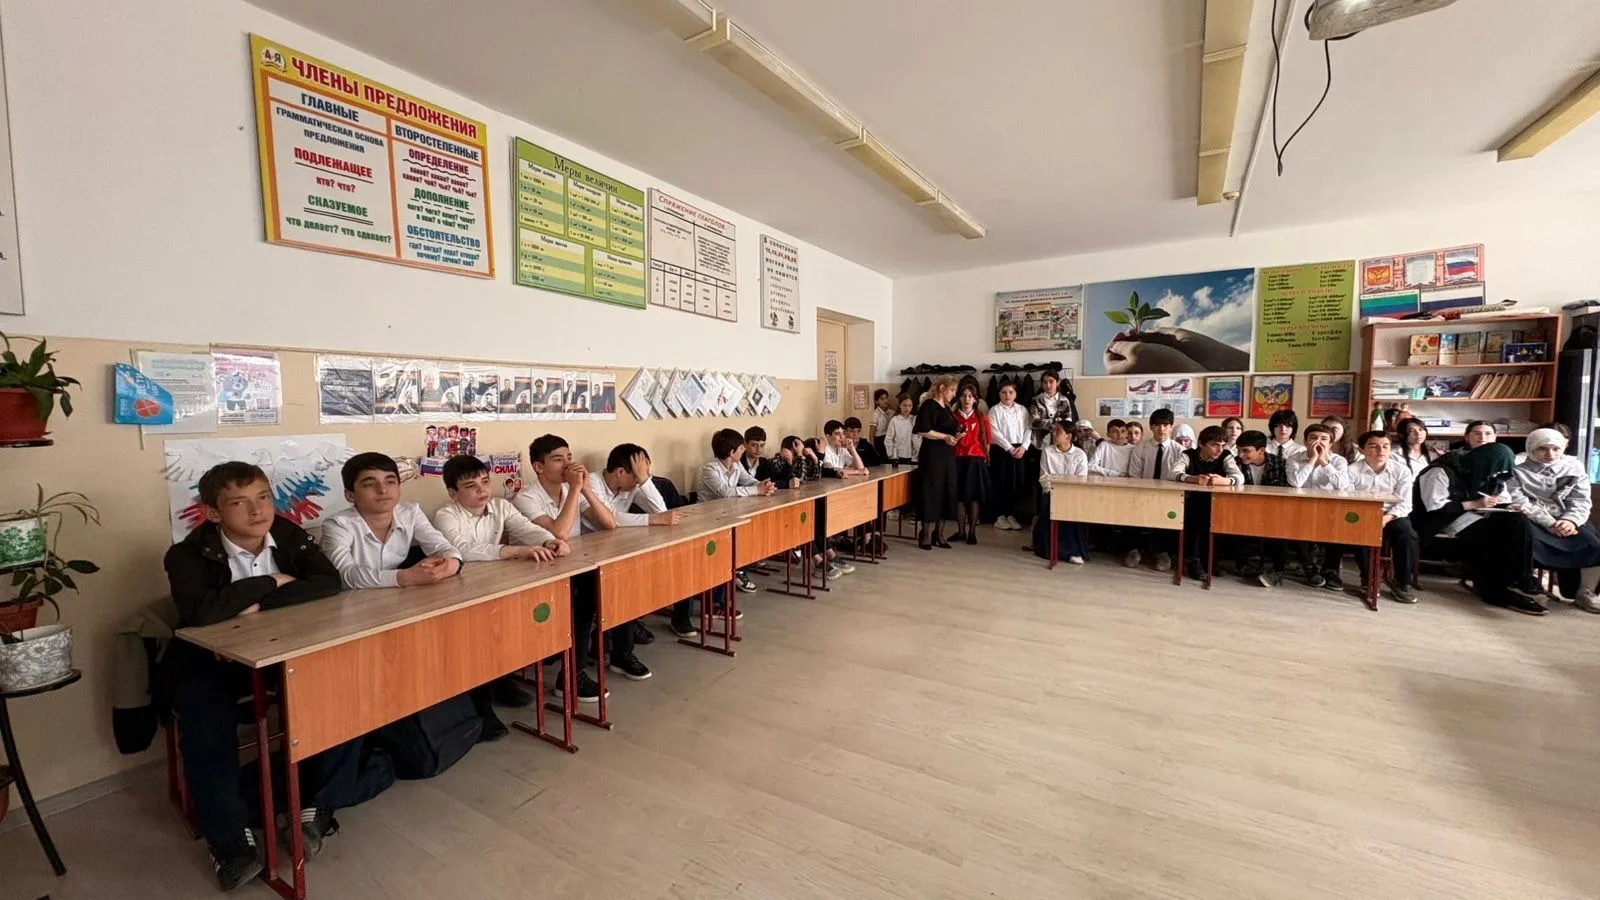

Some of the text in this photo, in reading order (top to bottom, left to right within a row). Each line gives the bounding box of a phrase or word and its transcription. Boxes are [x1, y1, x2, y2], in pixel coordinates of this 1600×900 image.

[292, 56, 478, 139] ЧЛЕНЫ ПРЕДЛОЖЕНИЯ
[301, 93, 359, 122] ГЛАВНЫЕ
[276, 106, 384, 148] ГРАММАТИЧЕСКАЯ ОСНОВА
[304, 129, 364, 154] ПРЕДЛОЖЕНИЯ
[395, 124, 480, 162] ВТОРОСТЕПЕННЫЕ
[294, 147, 372, 178] ПОДЛЕЖАЩЕЕ
[408, 148, 469, 175] ОПРЕДЕЛЕНИЕ
[554, 156, 582, 179] Меры
[585, 173, 618, 194] величин
[308, 195, 368, 217] СКАЗУЕМОЕ
[414, 188, 470, 210] ДОПОЛНЕНИЕ
[304, 220, 339, 235] делает?
[407, 224, 480, 248] ОБСТОЯТЕЛЬСТВО
[494, 465, 517, 474] СИЛА!
